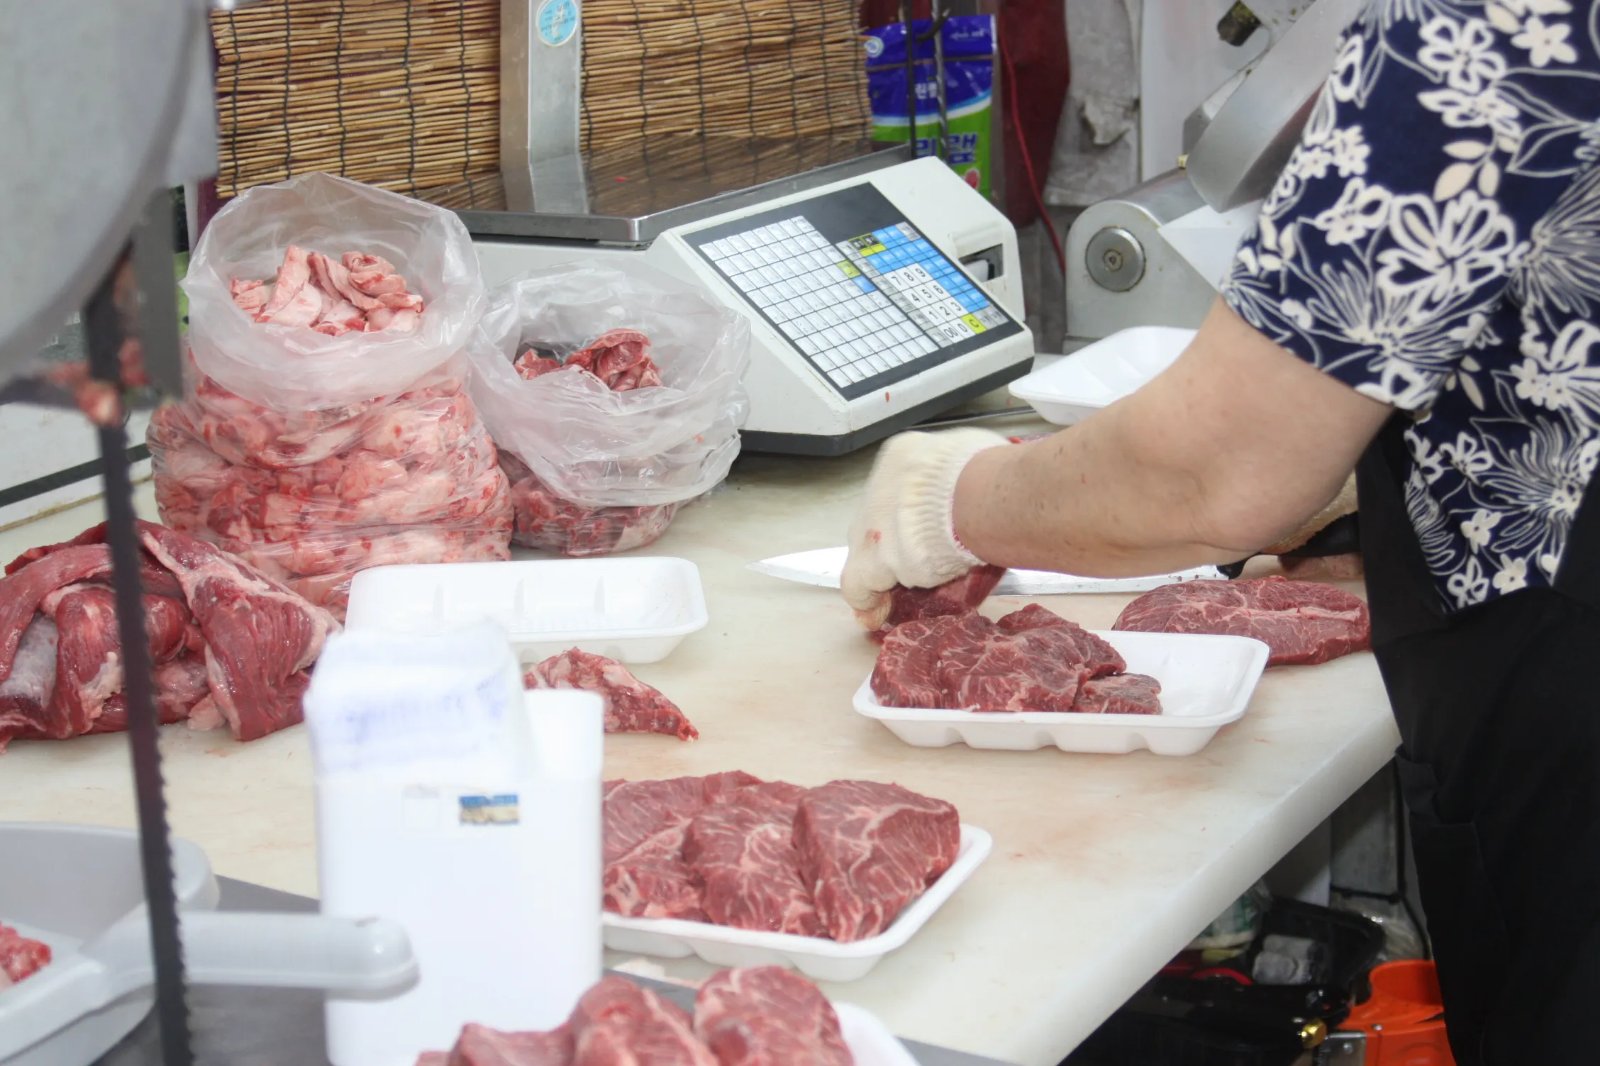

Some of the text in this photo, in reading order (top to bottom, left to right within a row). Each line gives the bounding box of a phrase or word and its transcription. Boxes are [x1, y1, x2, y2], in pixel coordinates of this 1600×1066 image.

[891, 268, 926, 286] 7 8 9
[911, 285, 944, 302] 4 5 6
[928, 302, 962, 320] 1 2 3
[957, 323, 968, 333] 0
